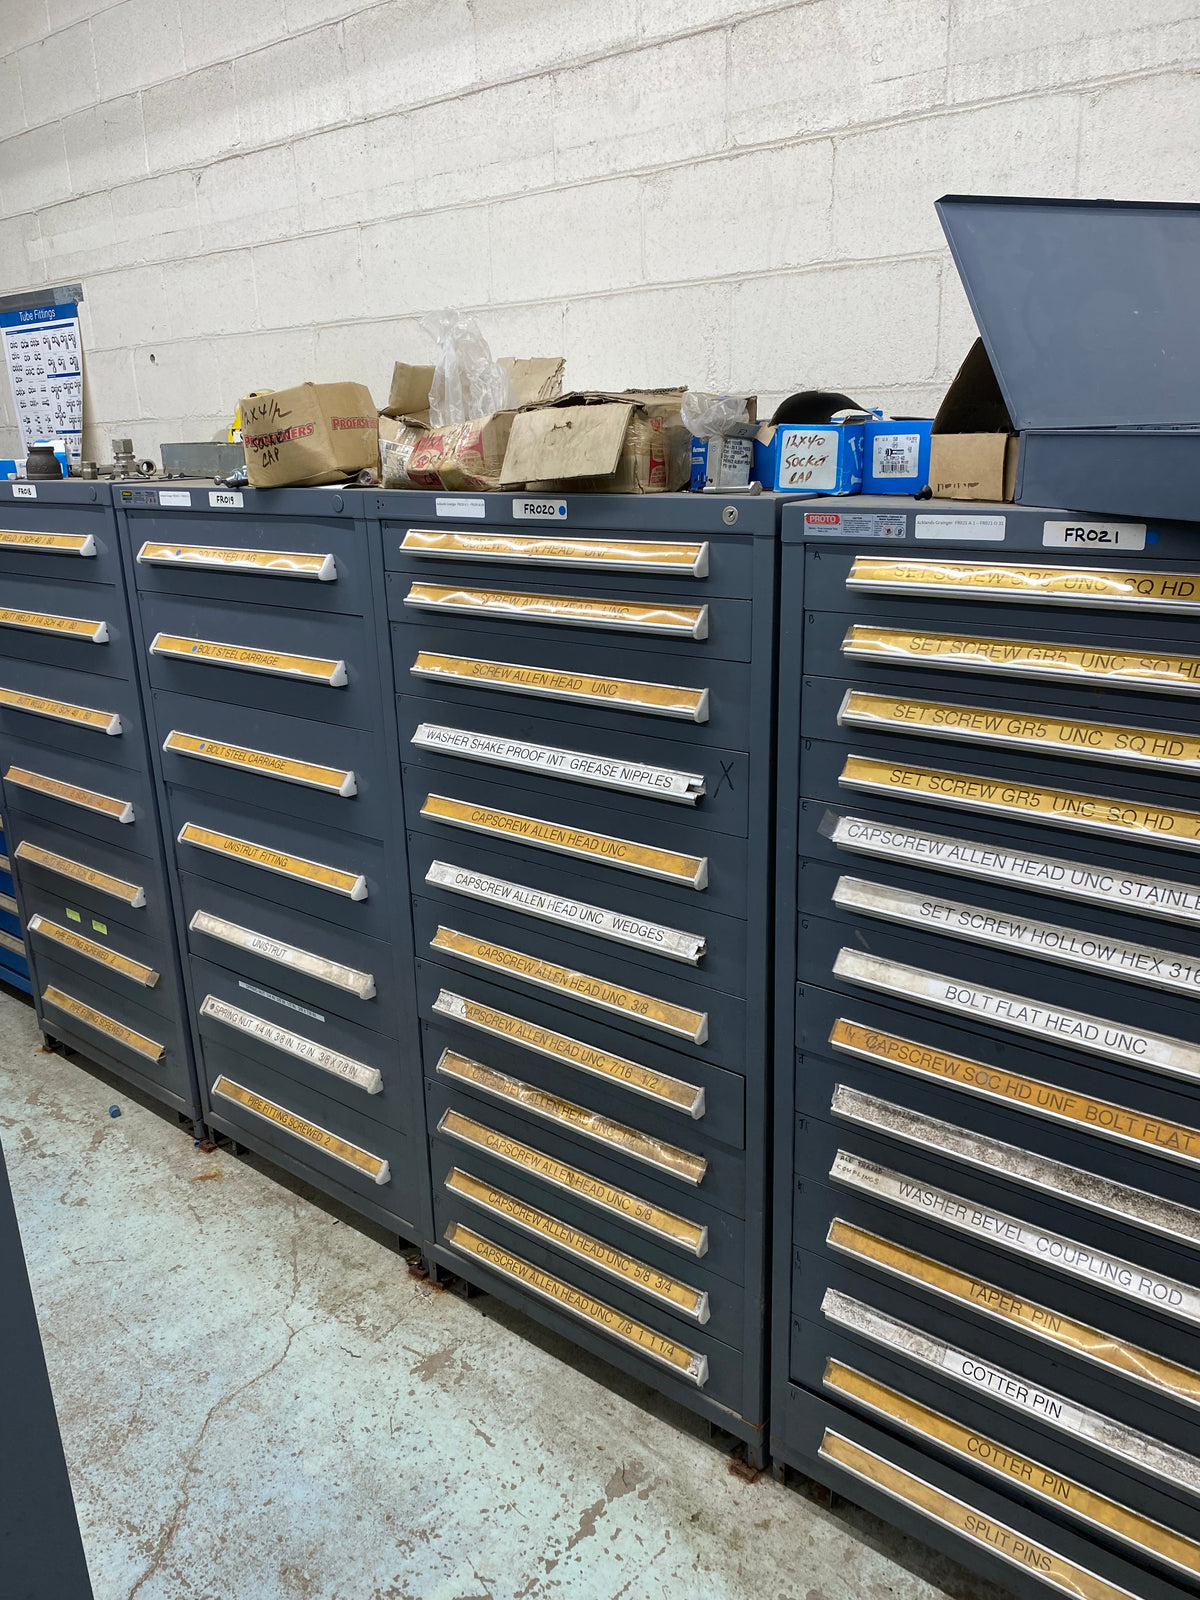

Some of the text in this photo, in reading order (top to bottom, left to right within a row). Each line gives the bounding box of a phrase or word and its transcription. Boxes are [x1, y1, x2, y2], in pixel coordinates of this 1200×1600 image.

[19, 308, 56, 321] Tube Fittings
[262, 447, 279, 468] CAP
[216, 495, 234, 505] FR019
[524, 503, 555, 515] FR020
[809, 515, 836, 523] PROTO
[217, 552, 239, 562] STEEL
[1064, 527, 1120, 544] FR021
[1160, 580, 1195, 598] HD
[196, 645, 280, 667] BOLT STEEL CARRIAGE
[472, 663, 619, 696] SCREW ALLEN HEAD UNC
[909, 636, 943, 652] SET
[948, 641, 1023, 660] SCREW
[1026, 648, 1069, 665] GR5
[1078, 653, 1127, 673] UNC
[206, 743, 288, 771] BOLT STEEL CARRIAGE
[893, 704, 926, 721] SET
[932, 709, 1003, 732] SCREW
[1006, 718, 1048, 738] GR5
[1058, 727, 1105, 747] UNC
[1114, 733, 1147, 753] SQ
[1151, 740, 1185, 758] HD
[426, 729, 673, 789] WASHER SHAKE PROOF INT GREASE NIPPLES
[889, 769, 924, 787] SET
[927, 776, 1000, 800] SCREW
[1002, 787, 1042, 808] GR5
[1052, 796, 1098, 818] UNC
[1106, 806, 1138, 826] SQ
[1143, 813, 1175, 832] HD
[223, 839, 289, 868] UNISTRUT FITTING
[471, 810, 627, 858] CAPSCREW ALLEN HEAD UNC
[847, 823, 946, 857] CAPSCREW
[948, 845, 1006, 870] ALLEN
[1010, 859, 1066, 882] HEAD
[1070, 870, 1115, 893] UNC
[455, 872, 665, 943] CAPSCREW ALLEN HEAD UNC WEDGES
[251, 938, 289, 959] UNISTRUT
[919, 902, 953, 923] SET
[958, 911, 1029, 941] SCREW
[1031, 928, 1118, 965] HOLLOW
[1120, 949, 1166, 975] HEX
[477, 944, 650, 1015] CAPSCREW ALLEN HEAD UNC 3/8
[214, 1005, 239, 1022] SPRING
[238, 1015, 253, 1028] NUT
[254, 1023, 265, 1035] 1/4
[460, 1003, 661, 1090] CAPSCREW ALLEN HEAD UNC 7/16 1/2
[944, 985, 1150, 1056] BOLT FLAT HEAD UNC
[471, 1067, 529, 1101] CAPSCREW
[527, 1092, 562, 1115] ALLEN
[560, 1105, 591, 1127] HEAD
[591, 1118, 615, 1138] UNC
[866, 1033, 962, 1078] CAPSCREW
[962, 1066, 1002, 1091] SOC
[1004, 1080, 1034, 1101] HD
[1036, 1089, 1078, 1113] UNF
[1083, 1105, 1137, 1133] BOLT
[1141, 1122, 1197, 1151] FLAT
[247, 1096, 332, 1147] PIPE FITTING SCREWED 2
[485, 1133, 653, 1221] CAPSCREW ALLEN HEAD UNC 5/8
[487, 1190, 673, 1294] CAPSCREW ALLEN HEAD UNC 5/8 3/4
[898, 1181, 1185, 1307] WASHER BEVEL COUPLING ROD
[476, 1242, 676, 1358] CAPSCREW ALLEN HEAD UNC 7/8 1 1 1/4
[967, 1280, 1064, 1333] TAPER PIN
[960, 1359, 1064, 1419] COTTER PIN
[966, 1436, 1072, 1500] COTTER PIN
[963, 1515, 1054, 1573] SPLIT PINS
